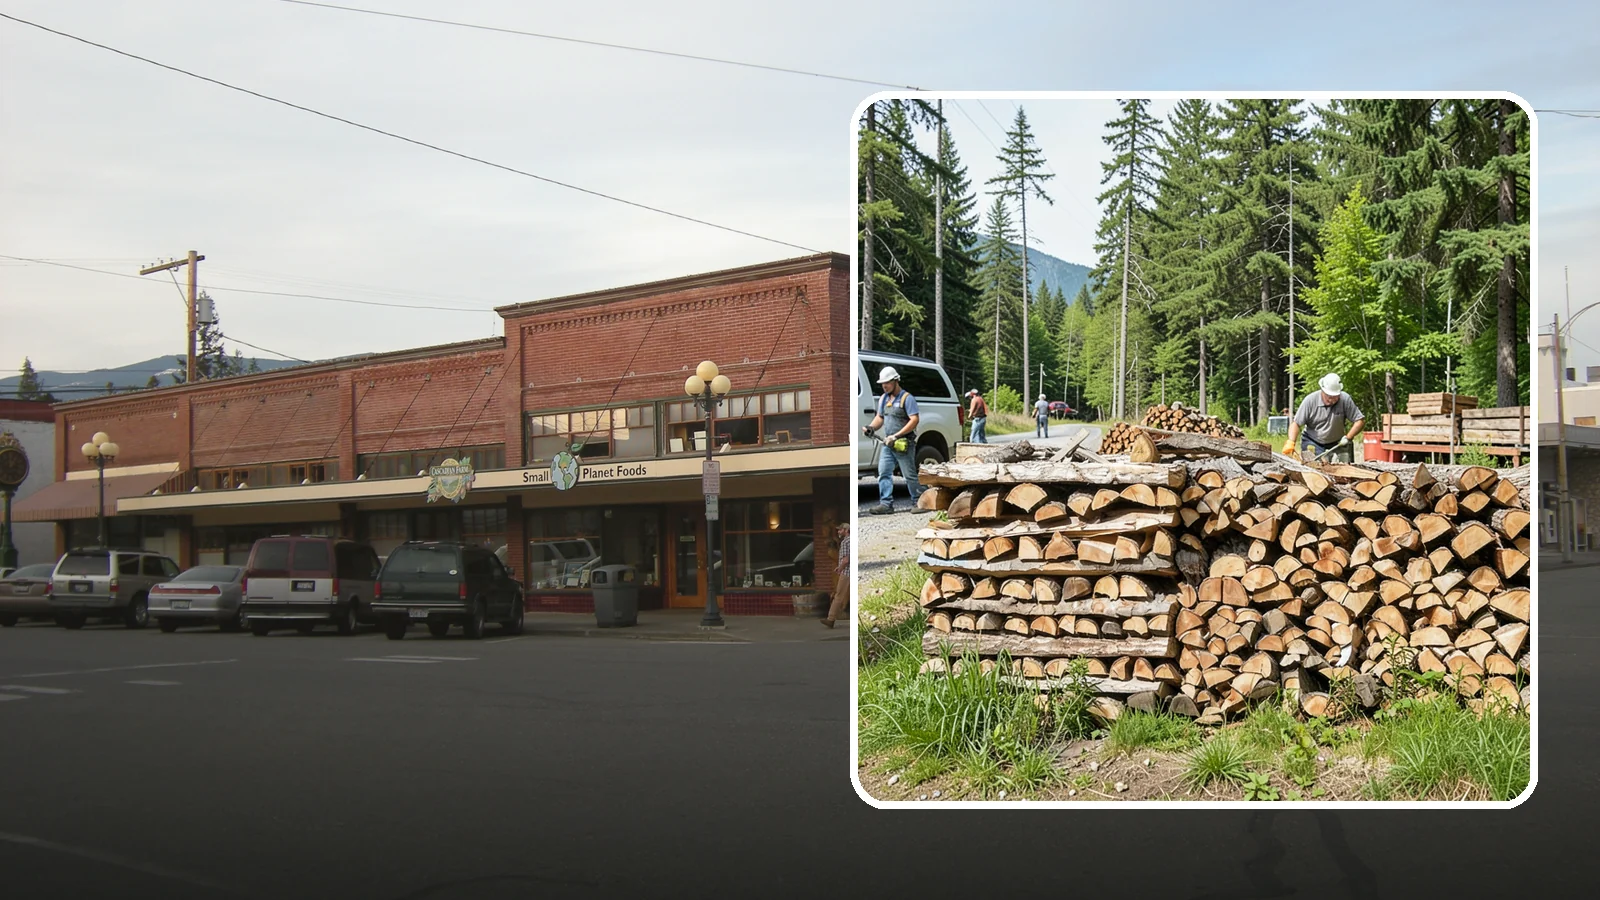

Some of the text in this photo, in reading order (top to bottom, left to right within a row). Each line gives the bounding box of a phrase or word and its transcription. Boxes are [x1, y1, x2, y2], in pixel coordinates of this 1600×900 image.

[523, 464, 647, 483] Small Planet Foods
